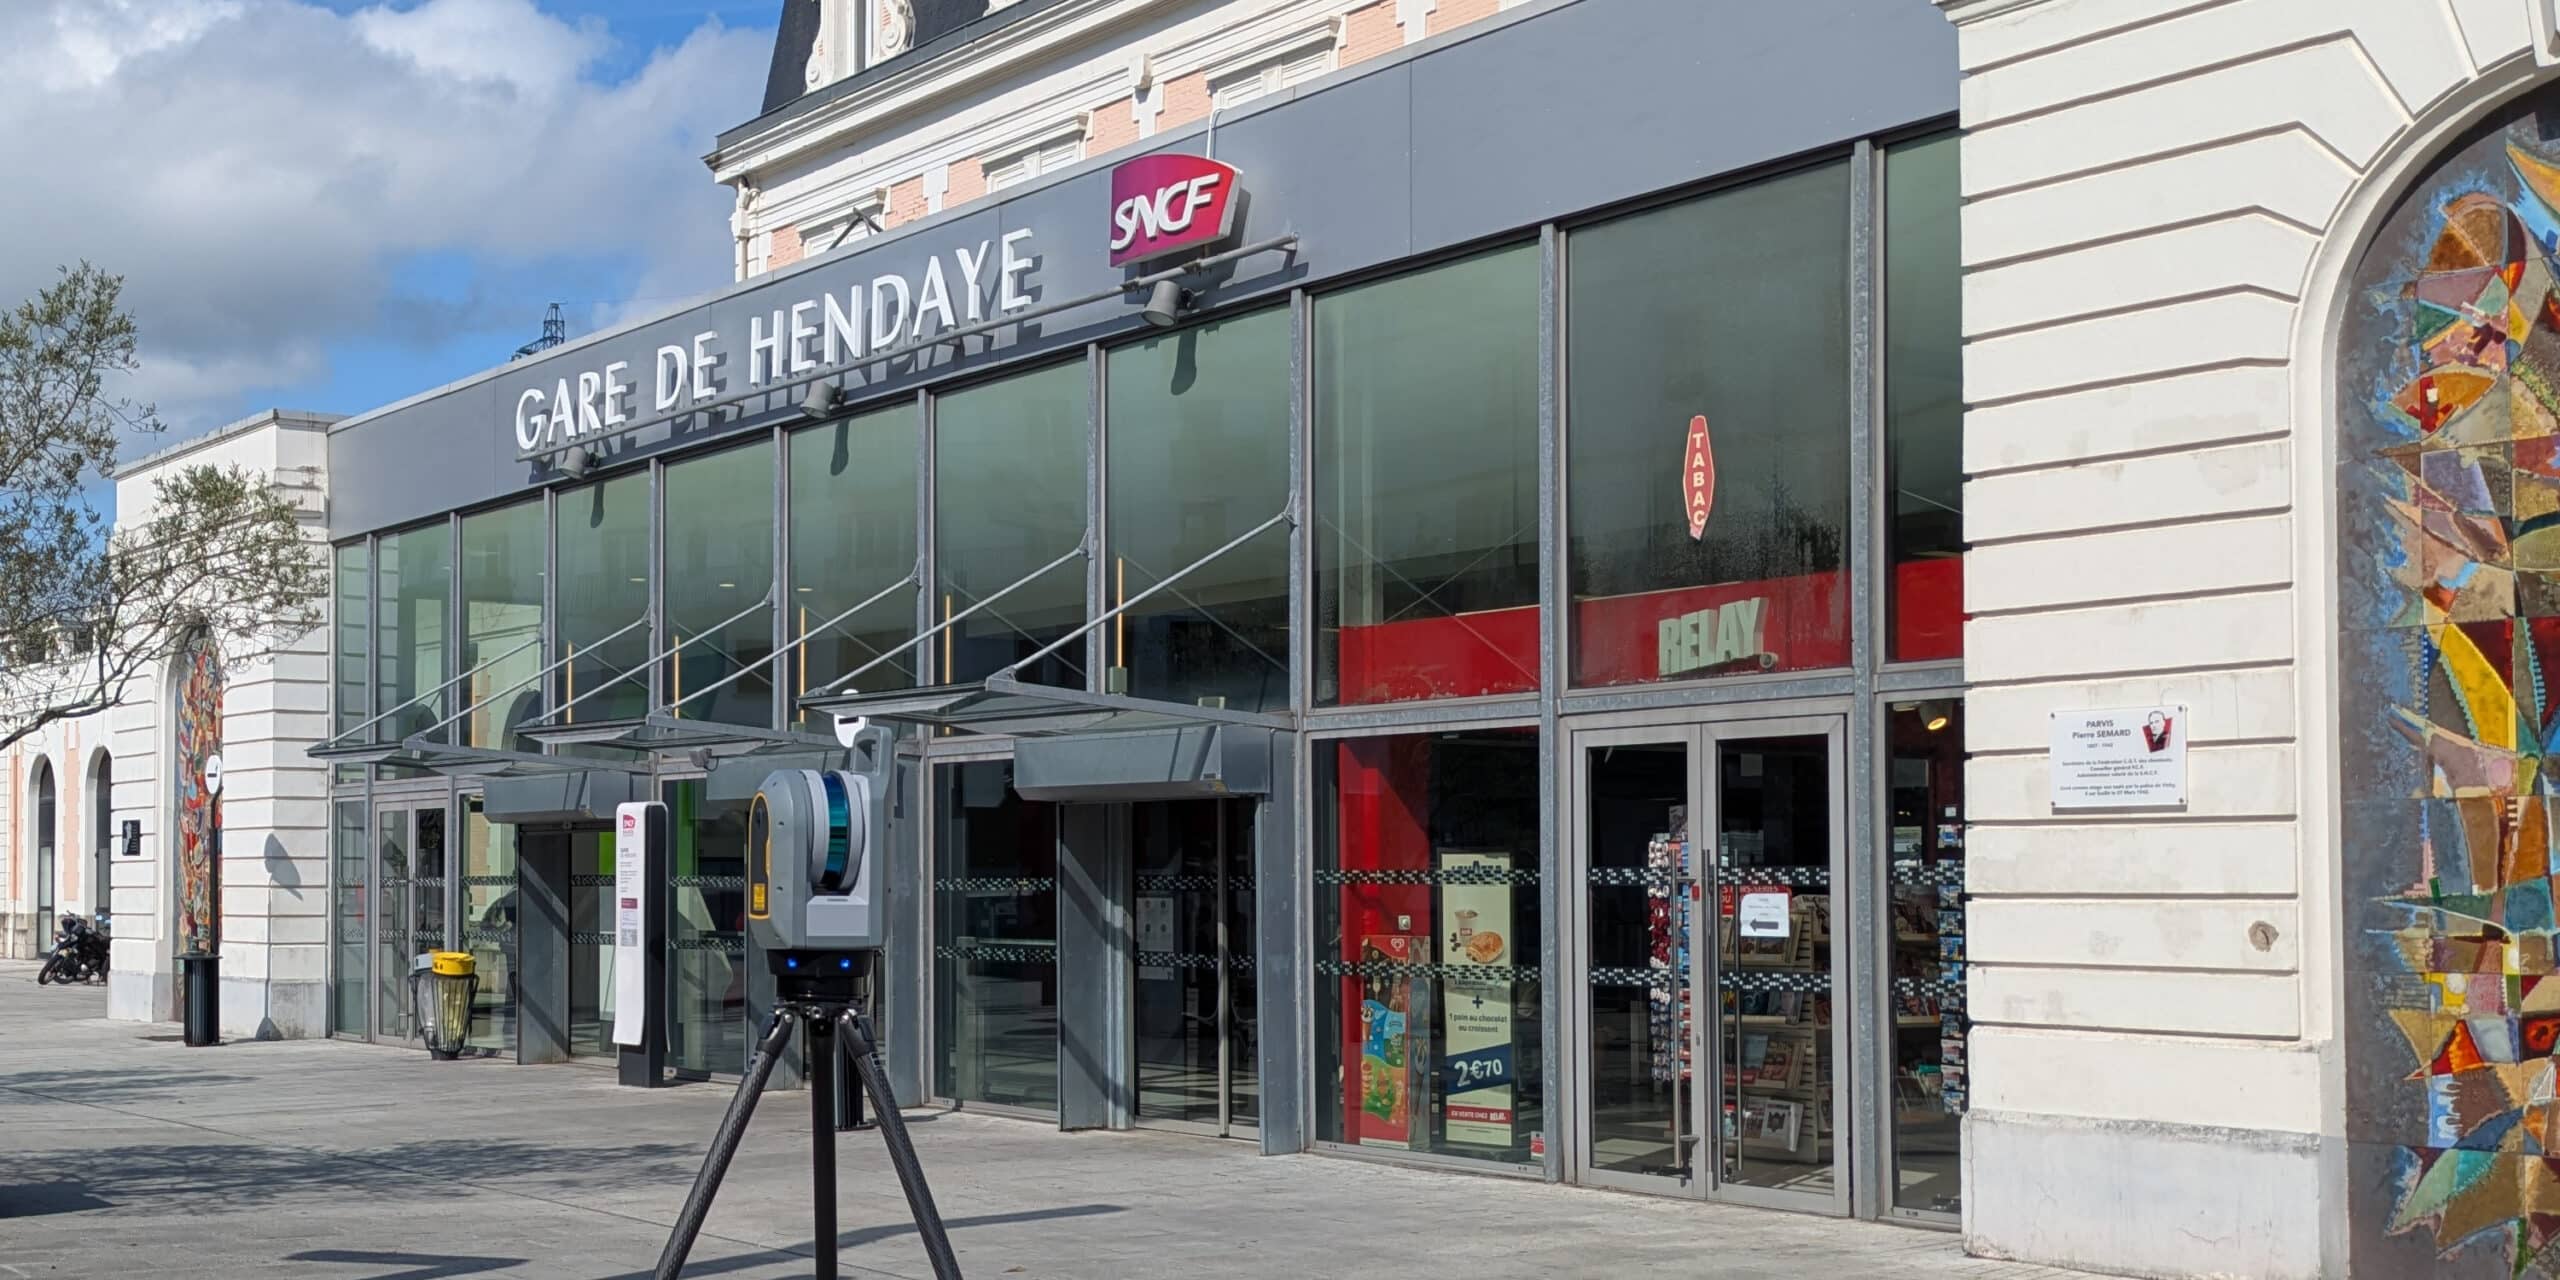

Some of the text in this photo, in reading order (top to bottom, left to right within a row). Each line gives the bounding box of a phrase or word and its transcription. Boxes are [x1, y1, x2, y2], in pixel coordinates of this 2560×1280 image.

[1110, 172, 1220, 250] SNCF
[515, 227, 1033, 450] GARE DE HENDAYE
[1692, 431, 1706, 527] TABAC
[1659, 597, 1768, 678] RELAY
[2072, 728, 2131, 739] Pierre SEMARD
[2086, 720, 2114, 728] PARVIS
[1454, 1014, 1468, 1022] pain
[1479, 1013, 1508, 1022] chocolat
[1468, 1025, 1498, 1033] croissant
[1454, 1058, 1503, 1088] 2€70
